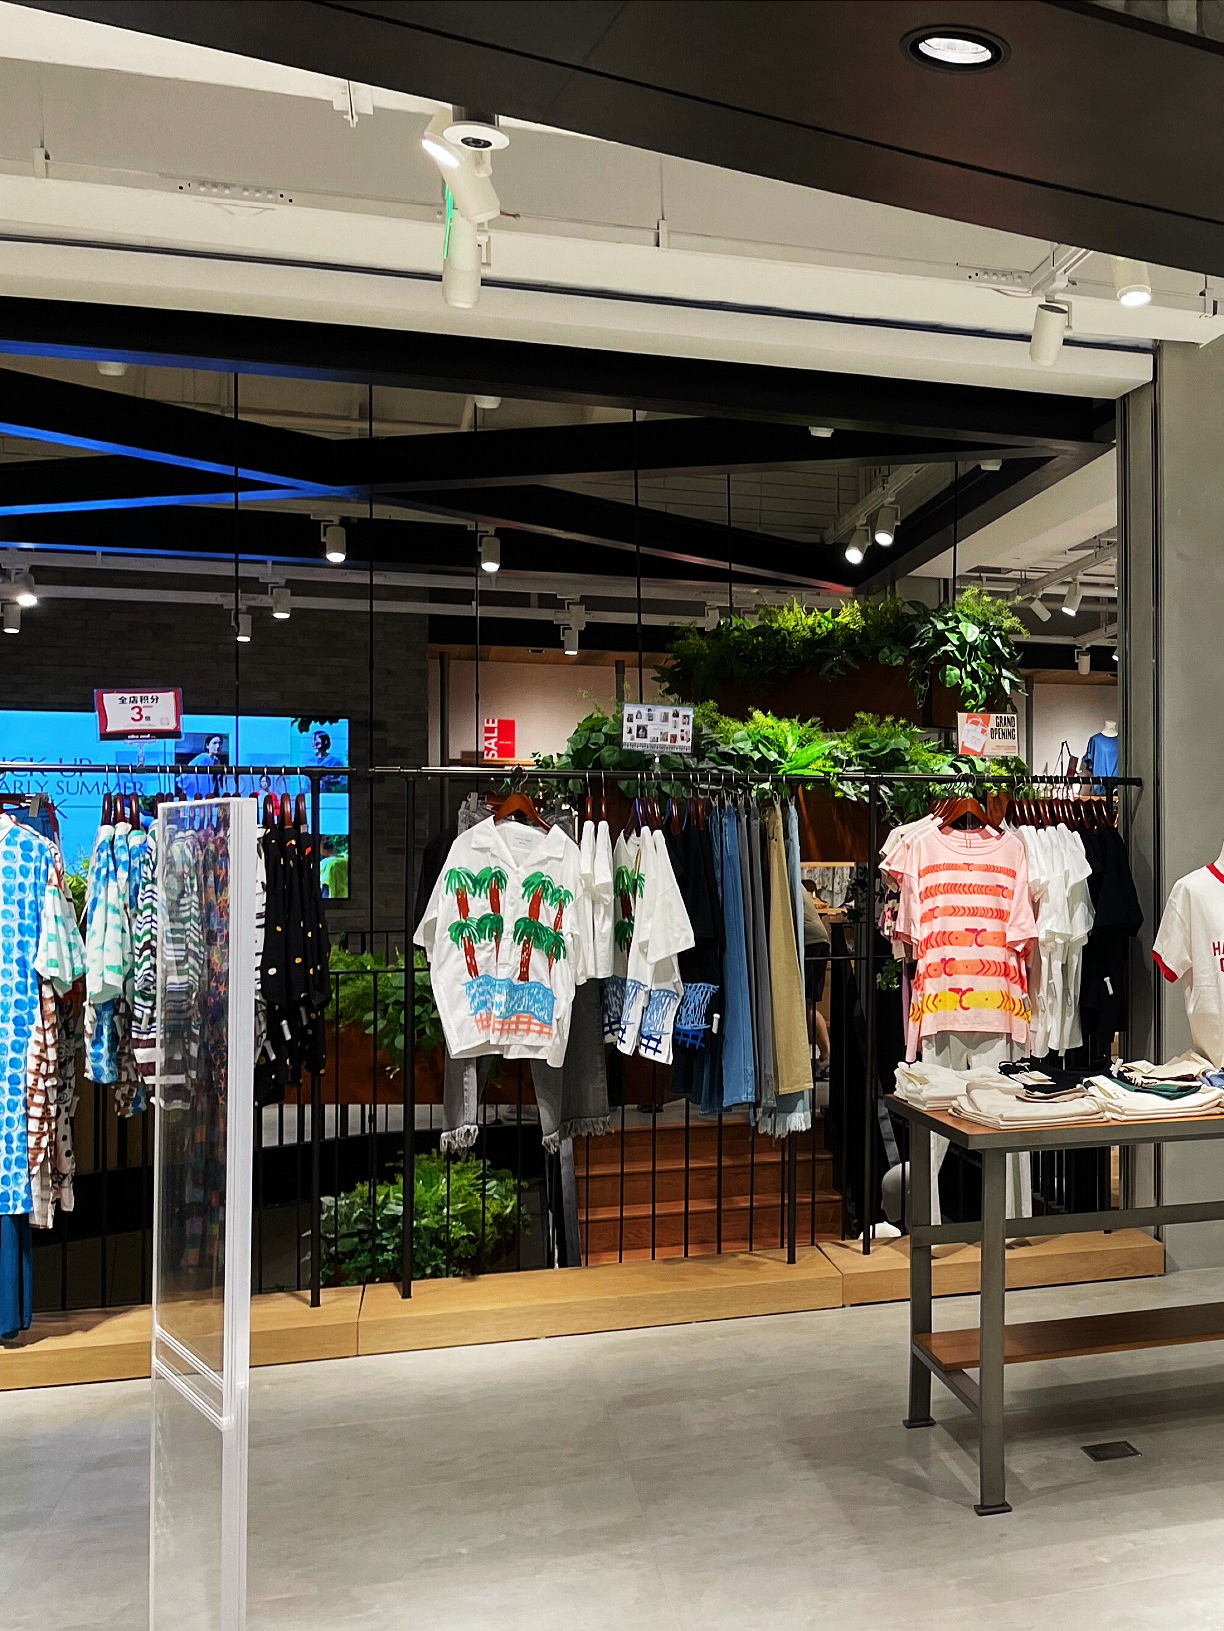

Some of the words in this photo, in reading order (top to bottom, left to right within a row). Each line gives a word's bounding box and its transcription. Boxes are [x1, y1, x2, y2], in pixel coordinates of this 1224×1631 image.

[118, 695, 159, 704] 全店积分
[995, 715, 1016, 727] GRAND
[484, 718, 498, 759] SALE
[990, 728, 1016, 740] OPENING
